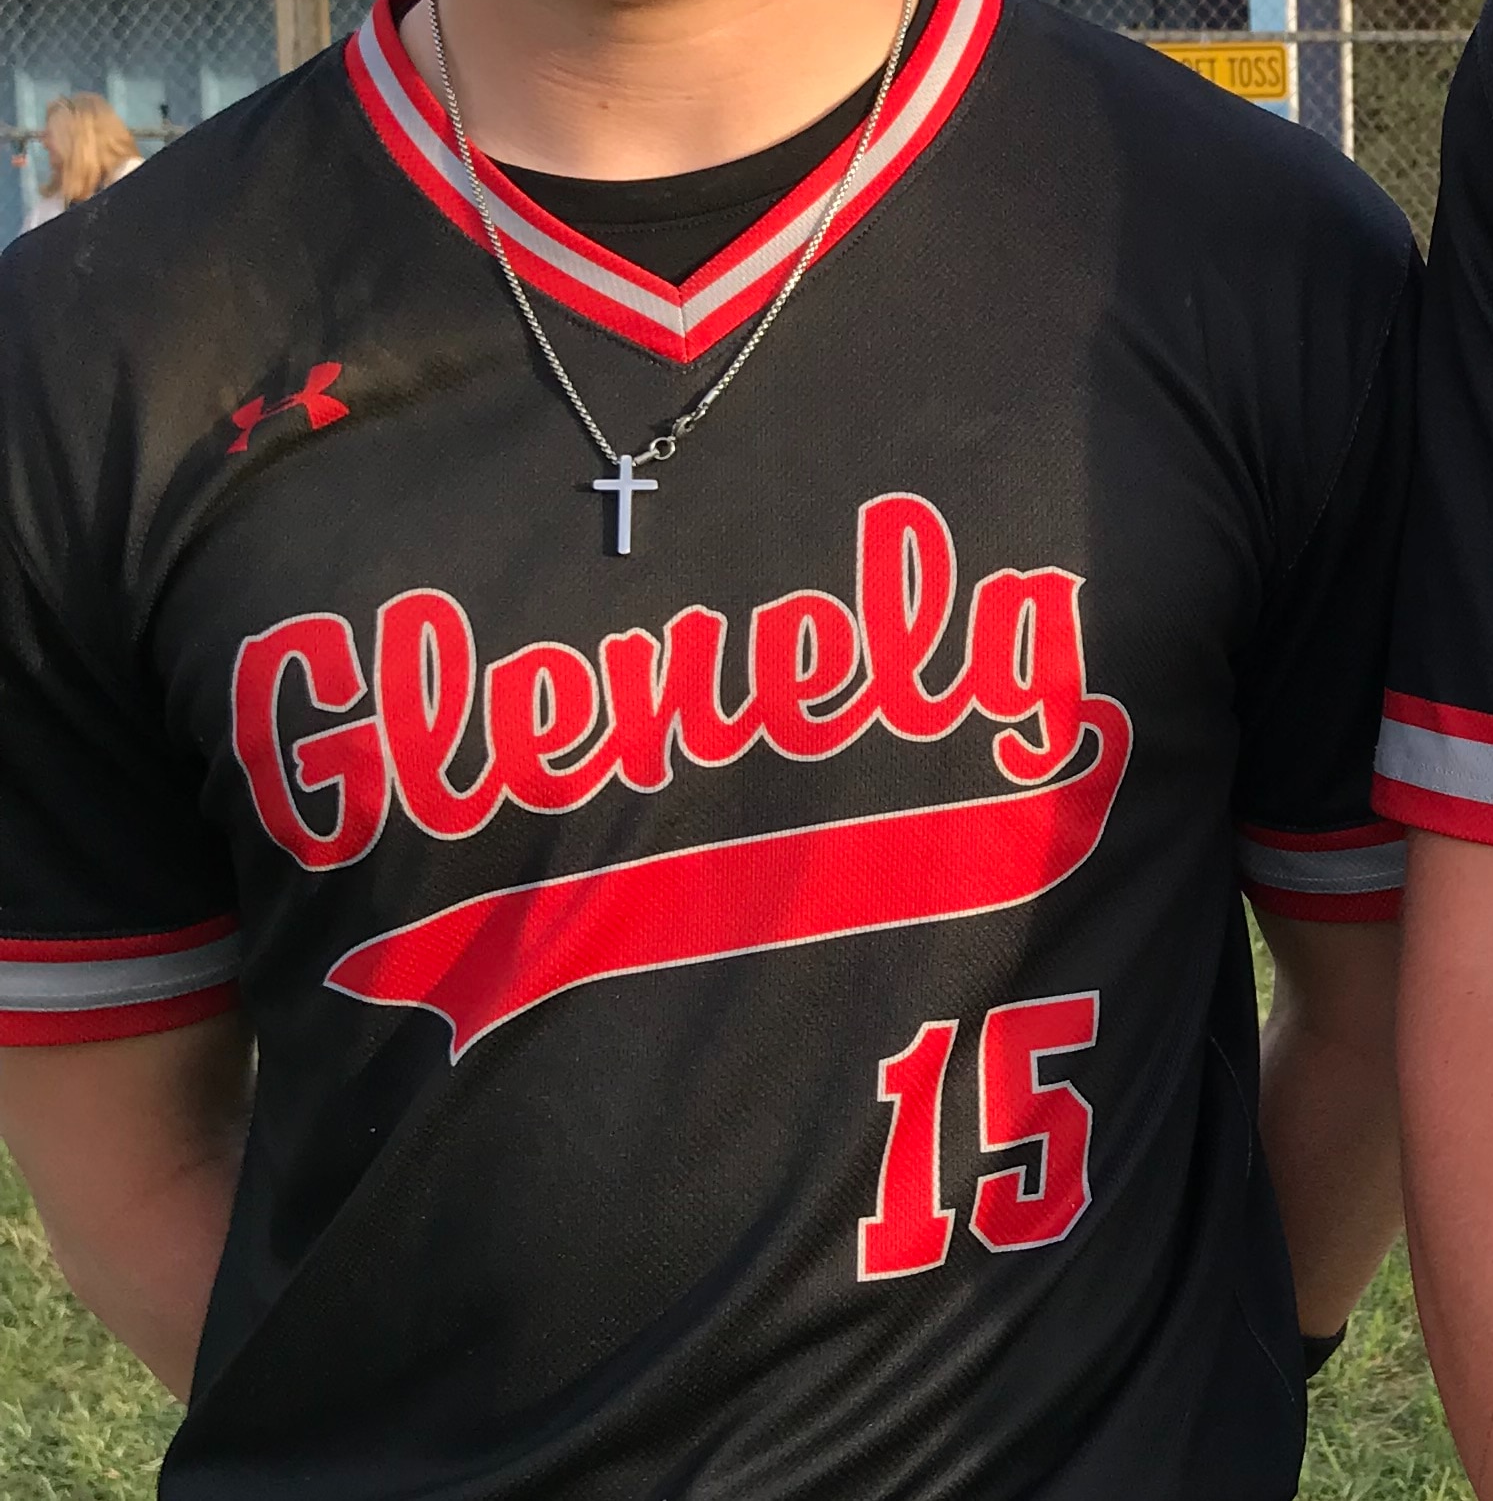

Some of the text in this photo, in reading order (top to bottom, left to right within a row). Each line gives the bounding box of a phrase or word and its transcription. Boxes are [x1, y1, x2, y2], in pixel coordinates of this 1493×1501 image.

[1227, 56, 1280, 88] TOSS
[231, 491, 1087, 872] Glenelg
[856, 989, 1100, 1282] 15
